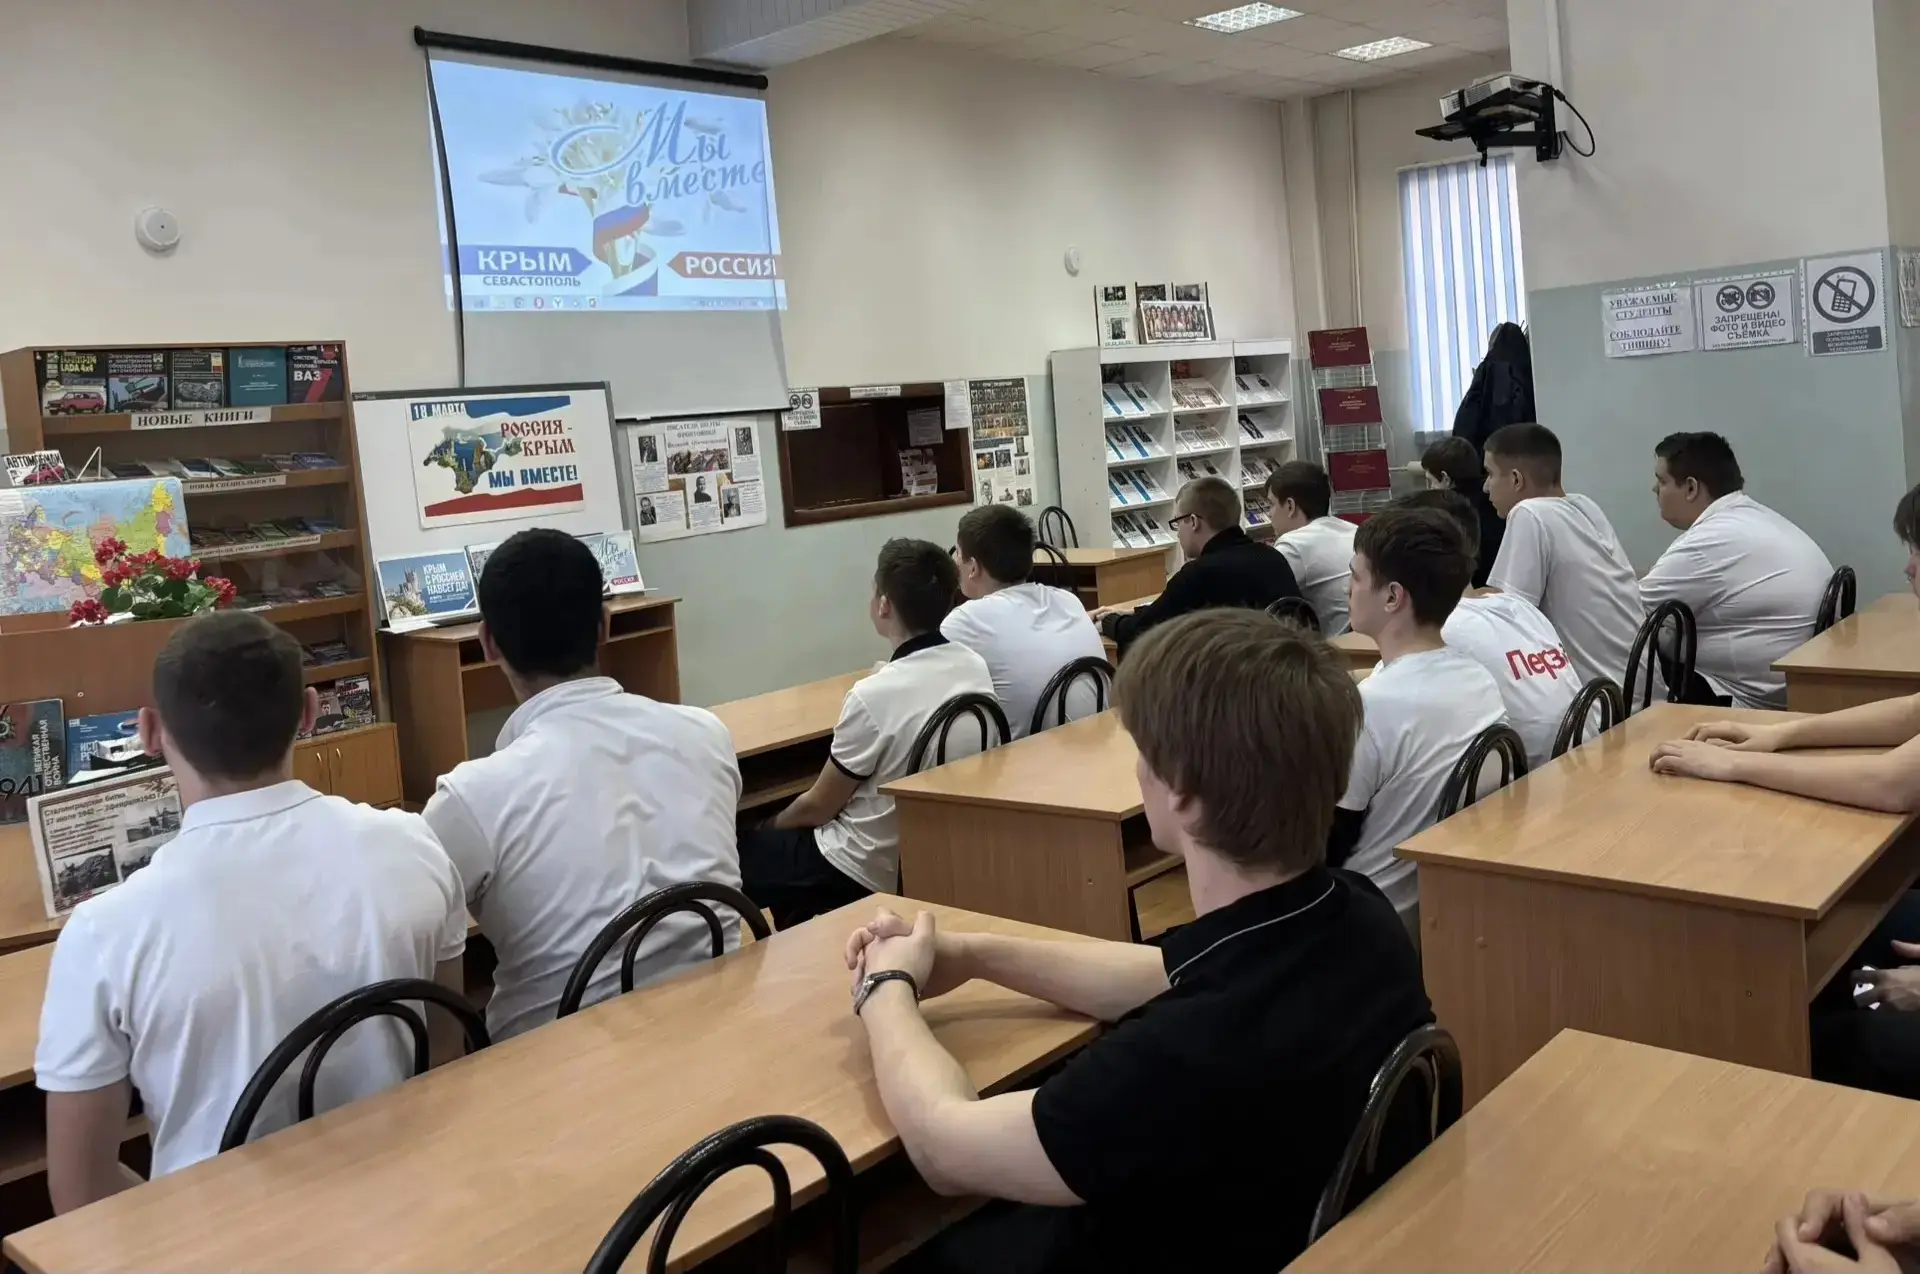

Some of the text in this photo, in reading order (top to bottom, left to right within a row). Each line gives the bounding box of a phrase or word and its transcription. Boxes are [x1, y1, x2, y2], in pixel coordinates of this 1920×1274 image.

[626, 158, 765, 206] вместе
[477, 250, 573, 273] КРЫМ
[684, 255, 777, 276] РОССИЯ
[482, 275, 582, 288] СЕВАСТОПОЛЬ
[1610, 293, 1678, 309] УВАЖАЕМЫЕ
[1615, 306, 1672, 320] СТУДЕНТЫ
[1714, 310, 1780, 324] ЗАПРЕЩЕНА!
[1609, 325, 1682, 341] СОБЛЮДАЙТЕ
[1710, 318, 1786, 332] ФОТО И ВИДЕО
[60, 363, 80, 373] LADA
[293, 370, 321, 381] ВАЗ
[137, 410, 254, 427] НОВЫЕ КНИГИ
[413, 402, 467, 420] 18 МАРТА
[500, 419, 564, 438] РОССИЯ
[522, 438, 576, 457] КРЫМ
[488, 464, 578, 488] МЫ ВМЕСТЕ!
[422, 562, 447, 575] КРЫМ
[432, 570, 466, 585] РОССИЕЙ
[427, 580, 469, 595] НАВСЕГДА!
[31, 733, 43, 773] ВЕЛИКАЯ
[39, 719, 53, 787] ОТЕЧЕСТВЕННАЯ
[51, 755, 61, 786] ВОЙНА
